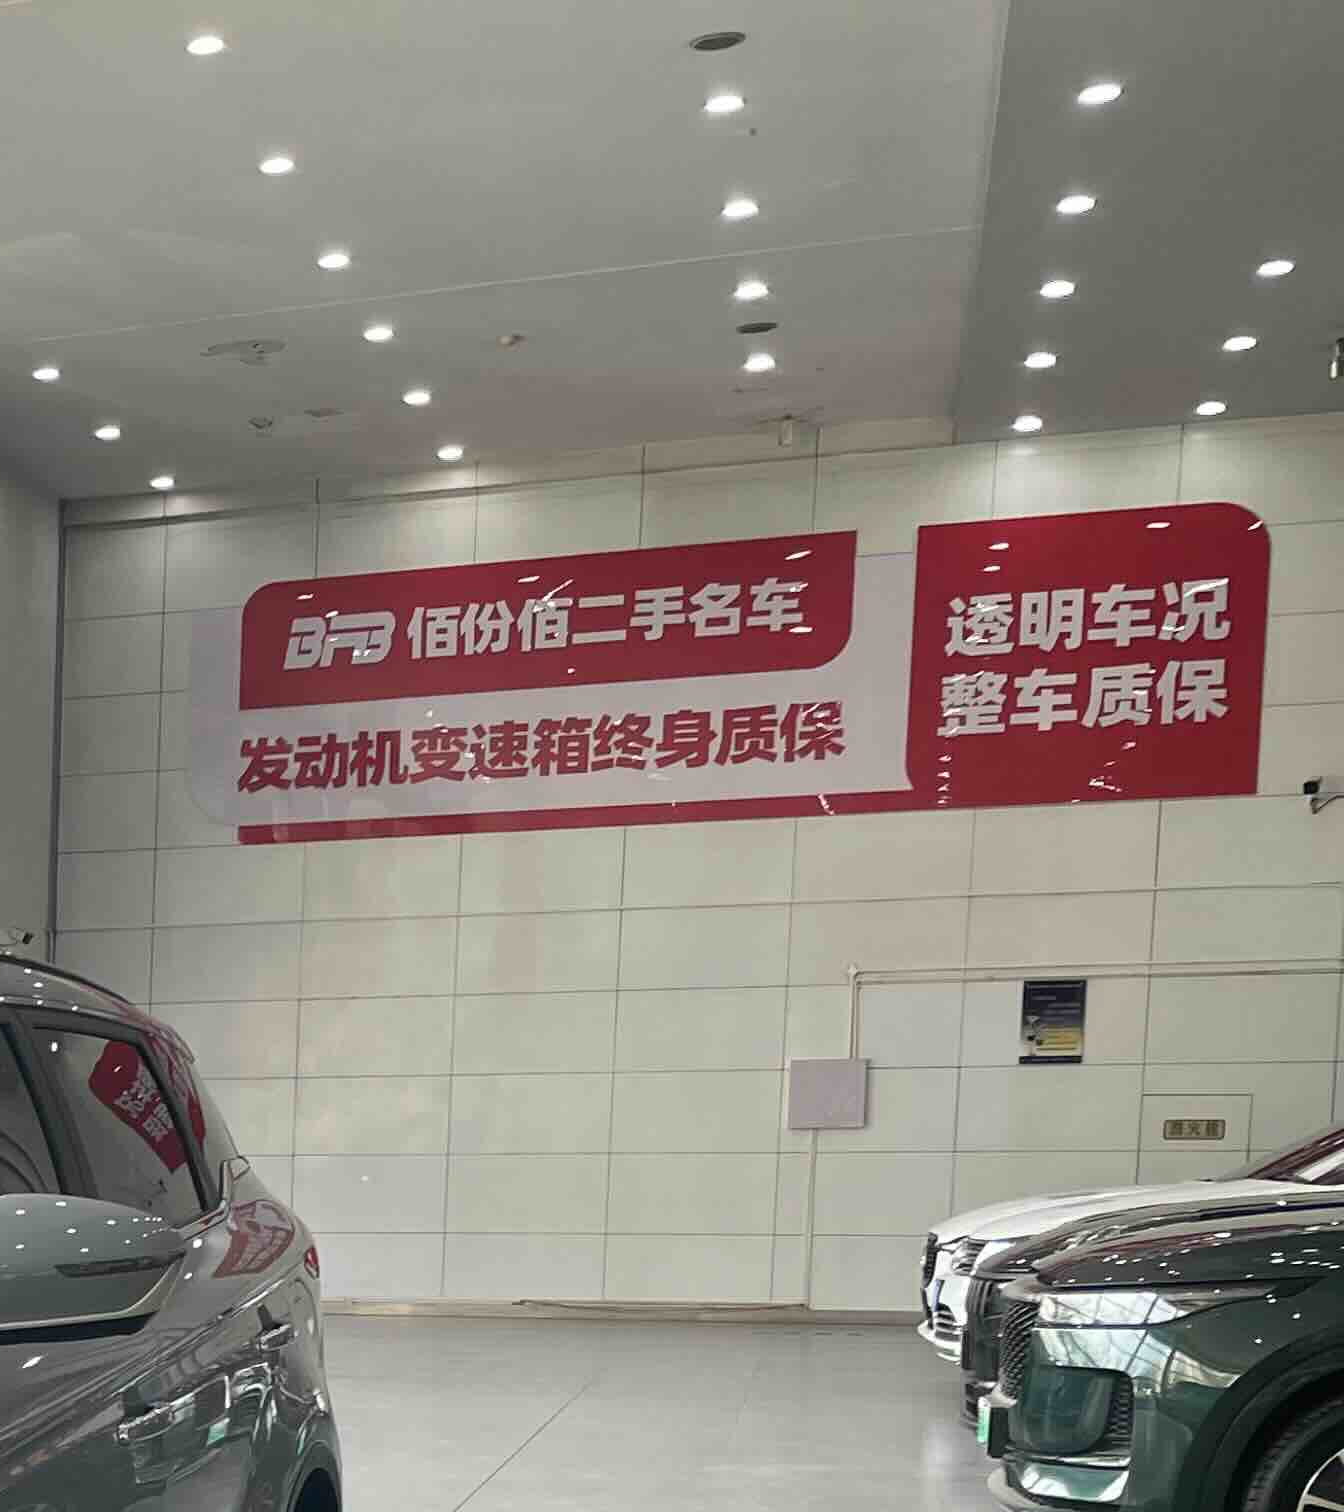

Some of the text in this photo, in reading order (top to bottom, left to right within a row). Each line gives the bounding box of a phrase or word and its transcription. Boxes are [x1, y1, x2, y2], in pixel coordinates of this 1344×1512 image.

[407, 578, 807, 660] 佰份佰二手名车
[944, 578, 1231, 656] 透明车况
[937, 659, 1229, 737] 整车质保
[238, 702, 845, 792] 发动机变速箱终身质保
